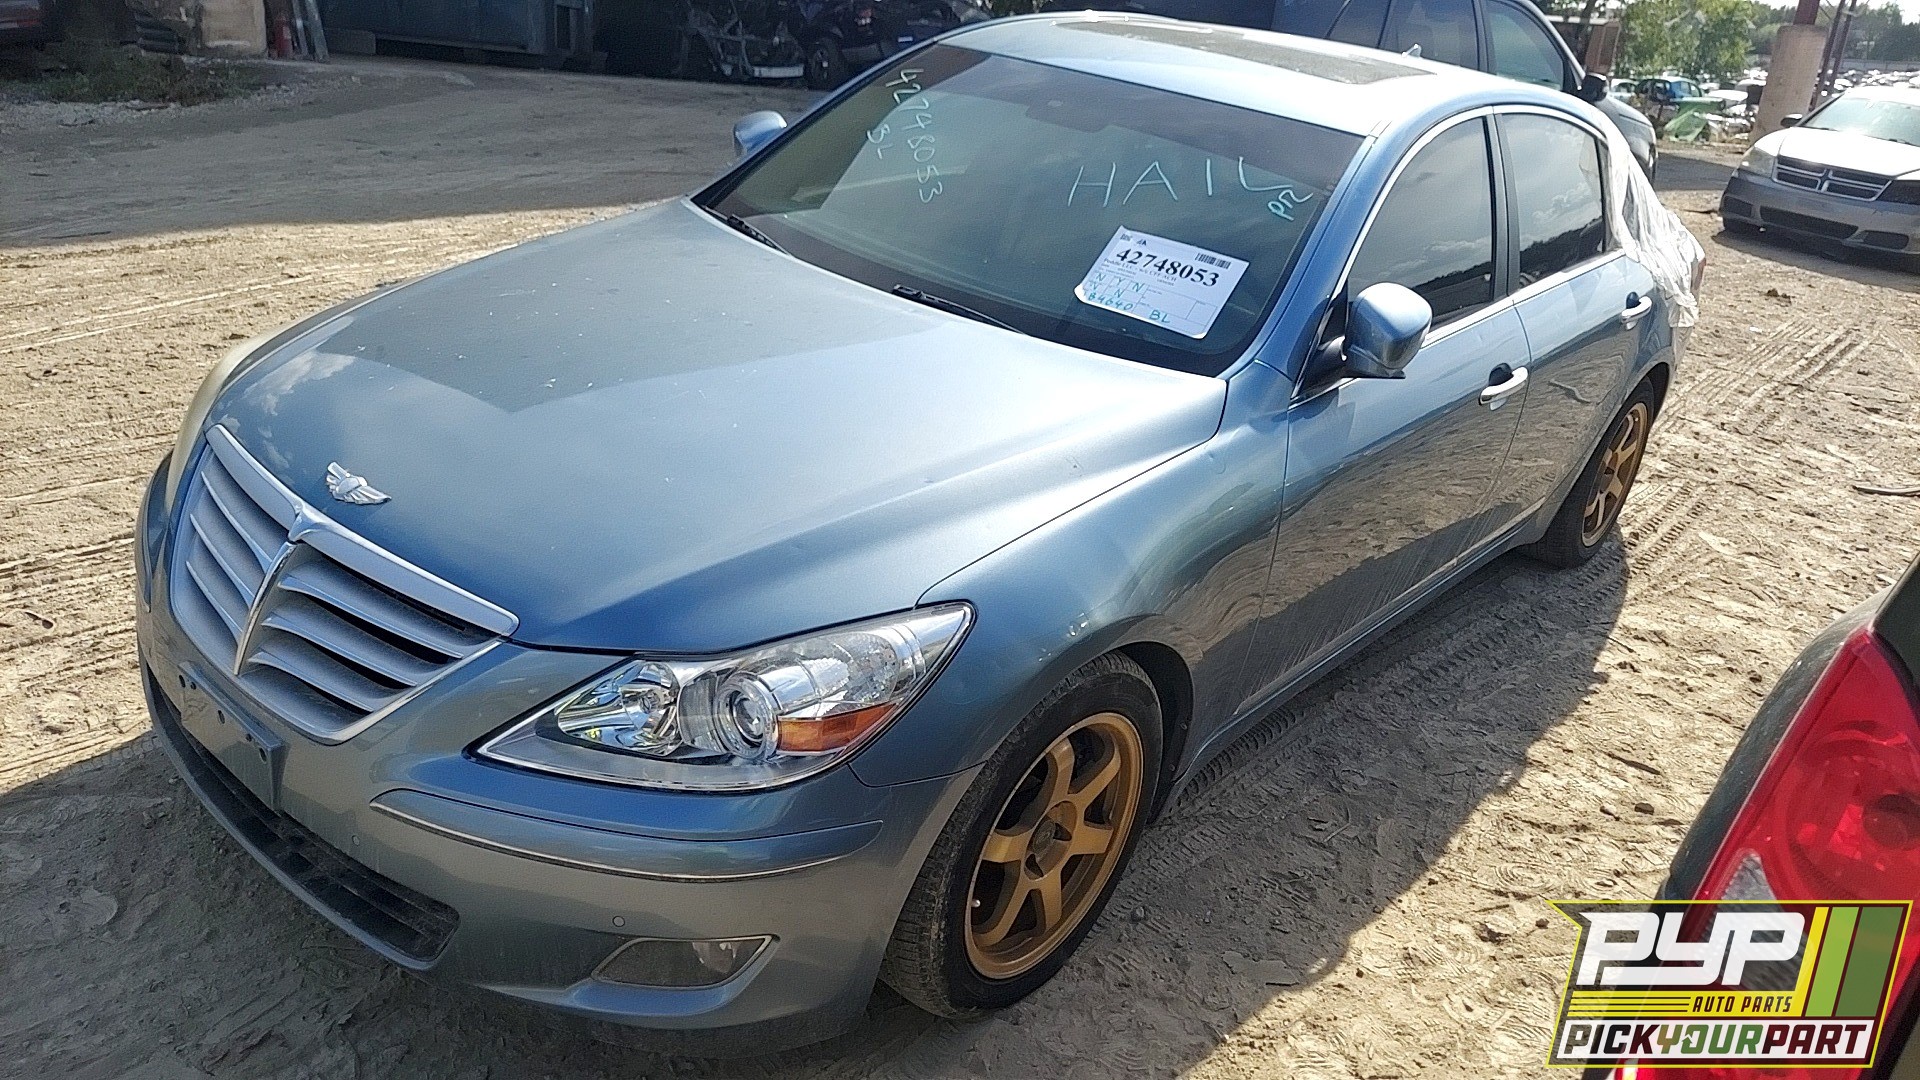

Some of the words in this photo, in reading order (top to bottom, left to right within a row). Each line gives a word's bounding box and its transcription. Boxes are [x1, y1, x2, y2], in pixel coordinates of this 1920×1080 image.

[886, 69, 943, 203] 42748053
[1067, 156, 1293, 208] HAIL
[1116, 248, 1220, 287] 42748053
[1149, 309, 1171, 323] BL
